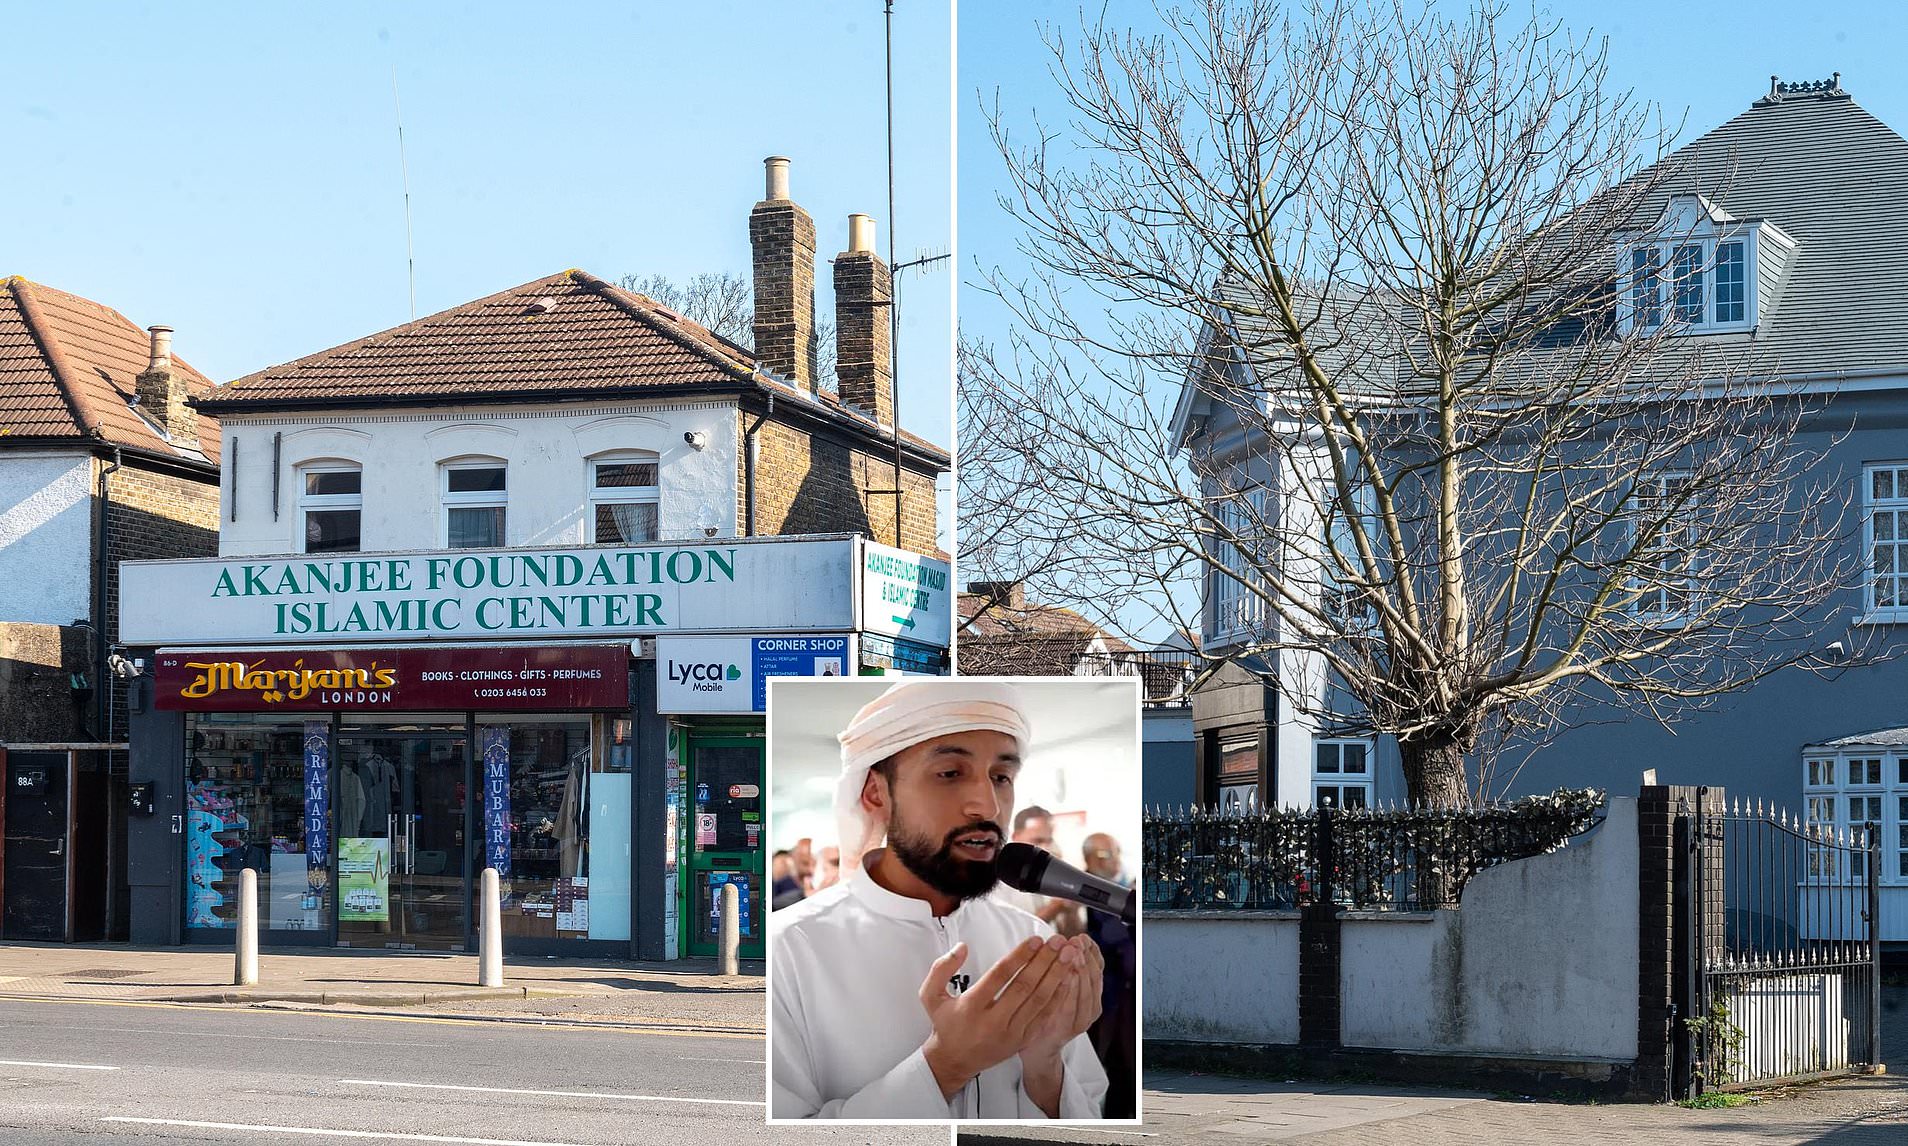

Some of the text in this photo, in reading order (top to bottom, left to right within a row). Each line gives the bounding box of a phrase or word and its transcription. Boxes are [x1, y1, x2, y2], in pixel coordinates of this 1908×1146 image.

[211, 549, 738, 597] AKANJEE FOUNDATION
[274, 593, 667, 634] ISLAMIC CENTER
[758, 639, 844, 651] CORNER SHOP
[422, 671, 454, 681] BOOKS
[460, 670, 513, 681] CLOTHINGS
[520, 669, 546, 680] GIFTS
[553, 669, 602, 679] PERFUMES
[668, 660, 723, 685] Lyca
[481, 688, 547, 697] 0203 6456 033
[692, 682, 723, 692] Mobile
[322, 691, 391, 703] LONDON
[17, 776, 34, 786] 88A
[309, 754, 323, 864] RAMADAN
[489, 762, 505, 876] MUBARAK
